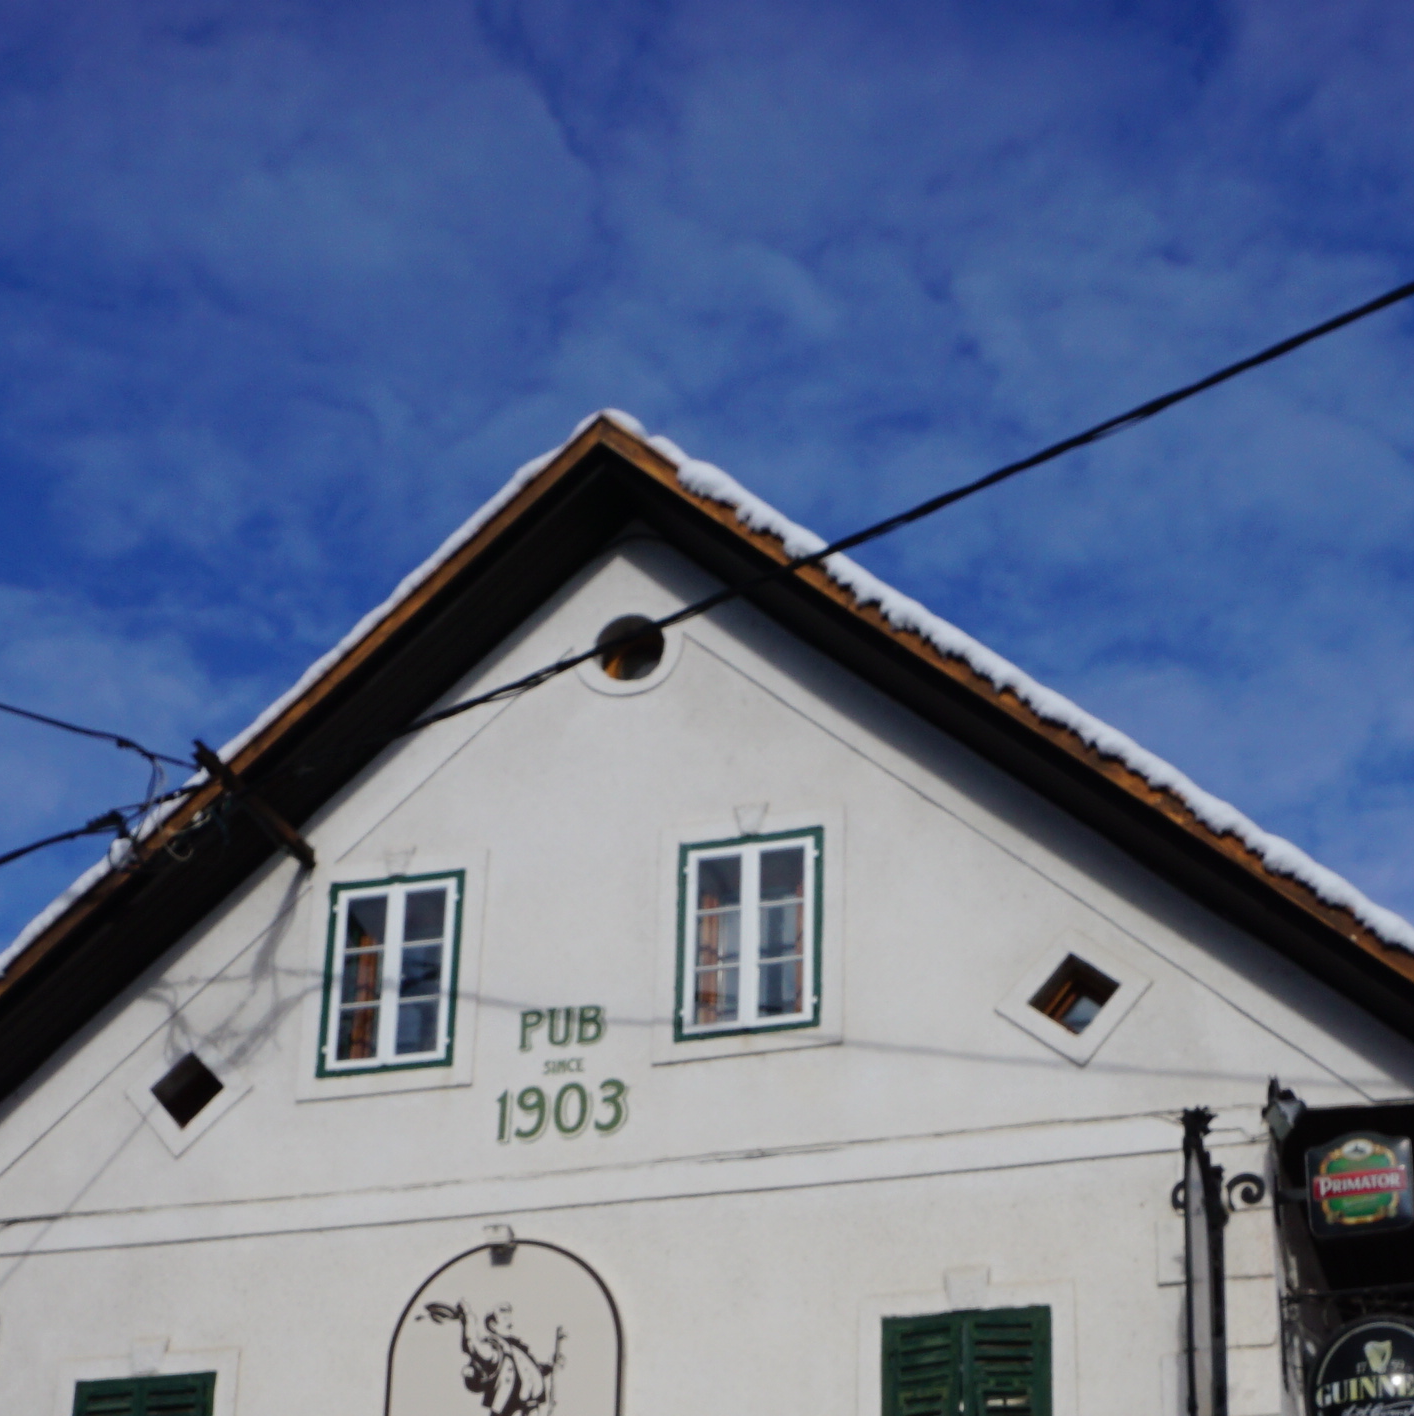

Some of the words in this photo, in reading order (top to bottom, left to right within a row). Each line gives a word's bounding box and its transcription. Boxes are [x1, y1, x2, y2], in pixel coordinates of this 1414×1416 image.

[519, 1005, 605, 1052] PUB
[542, 1057, 585, 1075] SINCE
[496, 1078, 629, 1144] 1903
